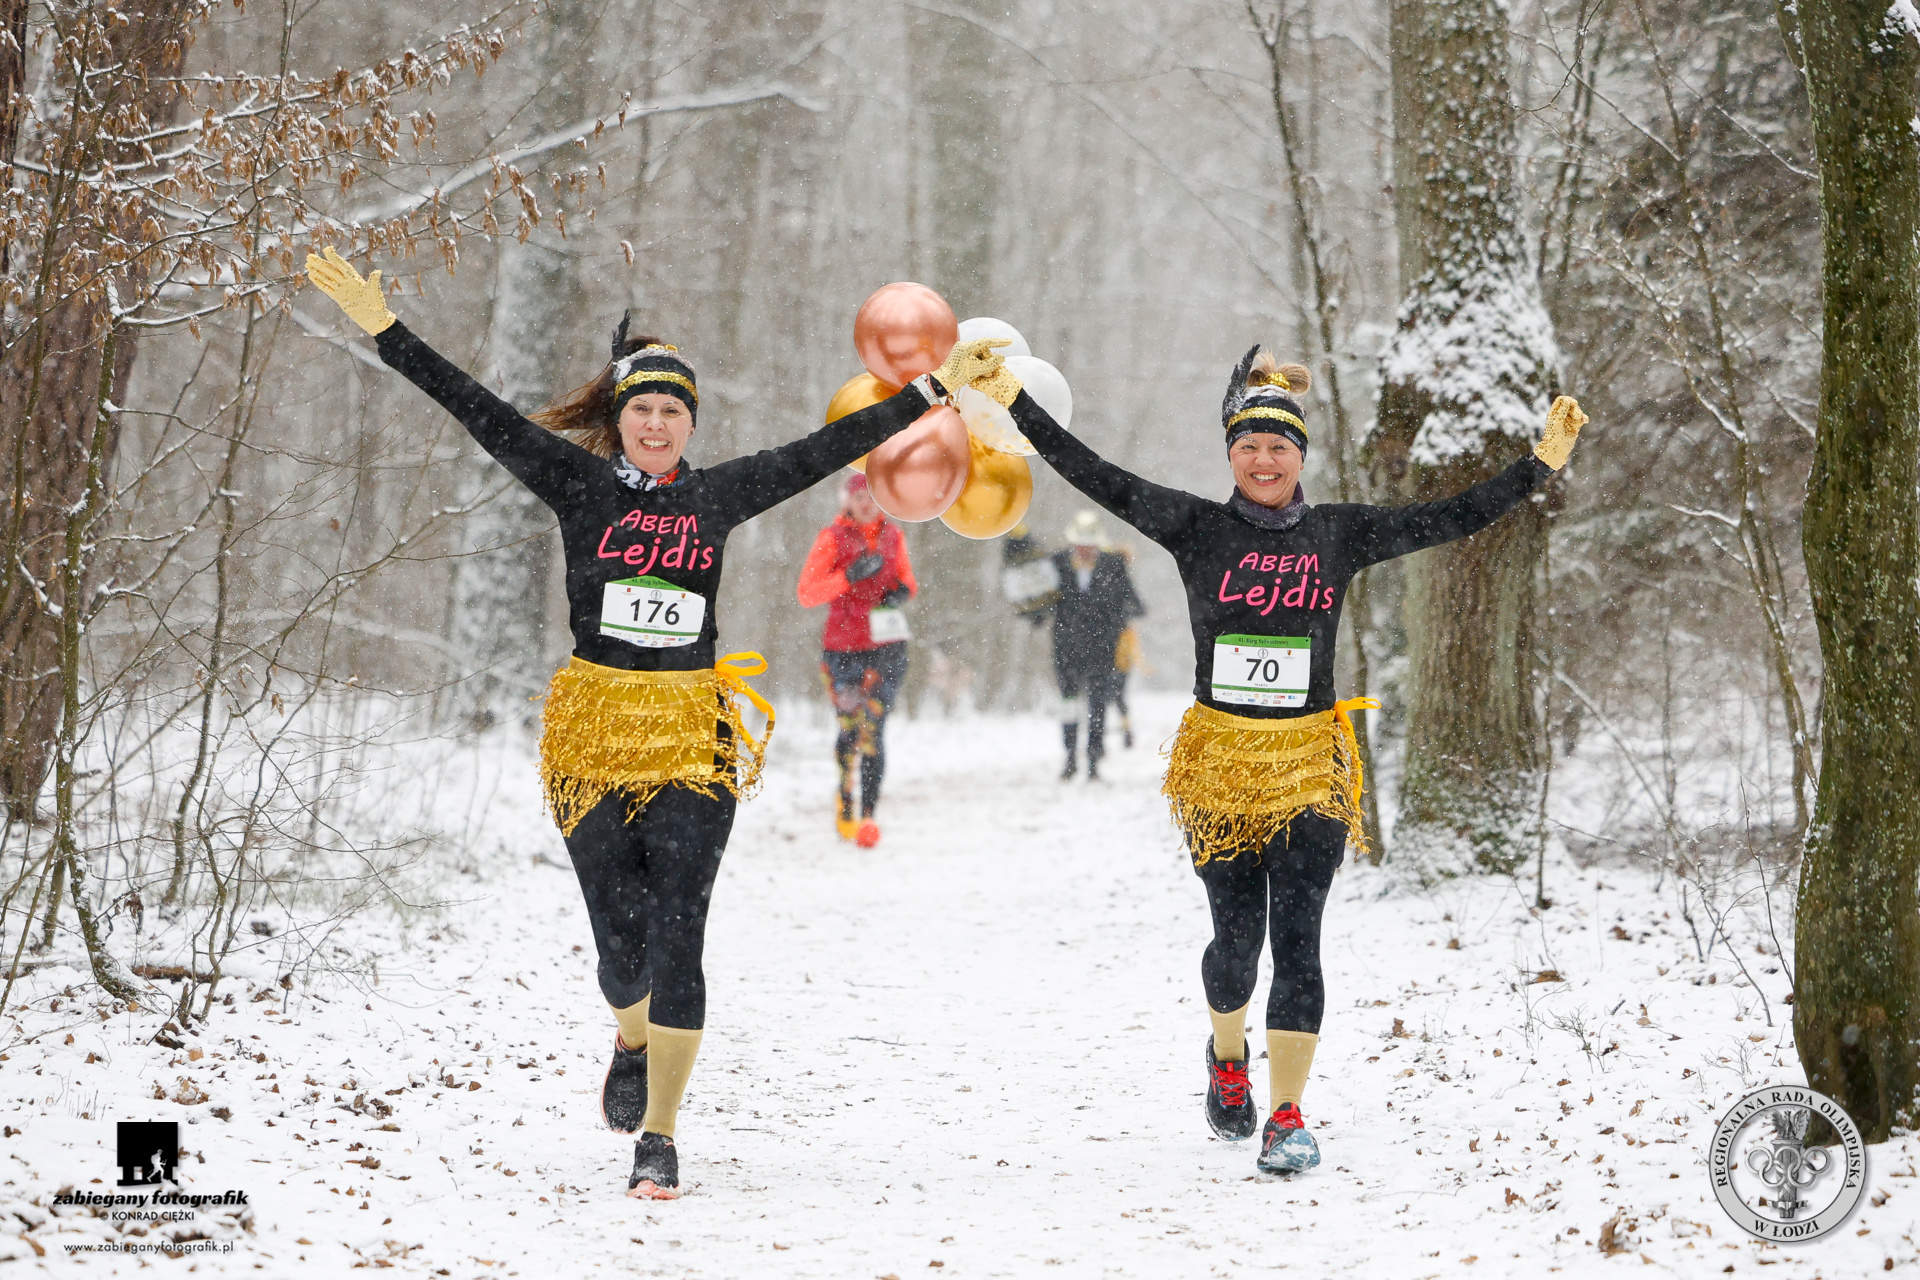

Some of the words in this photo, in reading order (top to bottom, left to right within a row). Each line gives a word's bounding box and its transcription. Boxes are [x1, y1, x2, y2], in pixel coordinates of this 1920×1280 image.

[619, 509, 698, 535] ABEM
[597, 526, 714, 576] Lejdis
[1238, 551, 1319, 574] ABEM
[1218, 570, 1334, 616] Lejdis
[630, 598, 680, 626] 176
[1246, 658, 1280, 683] 70
